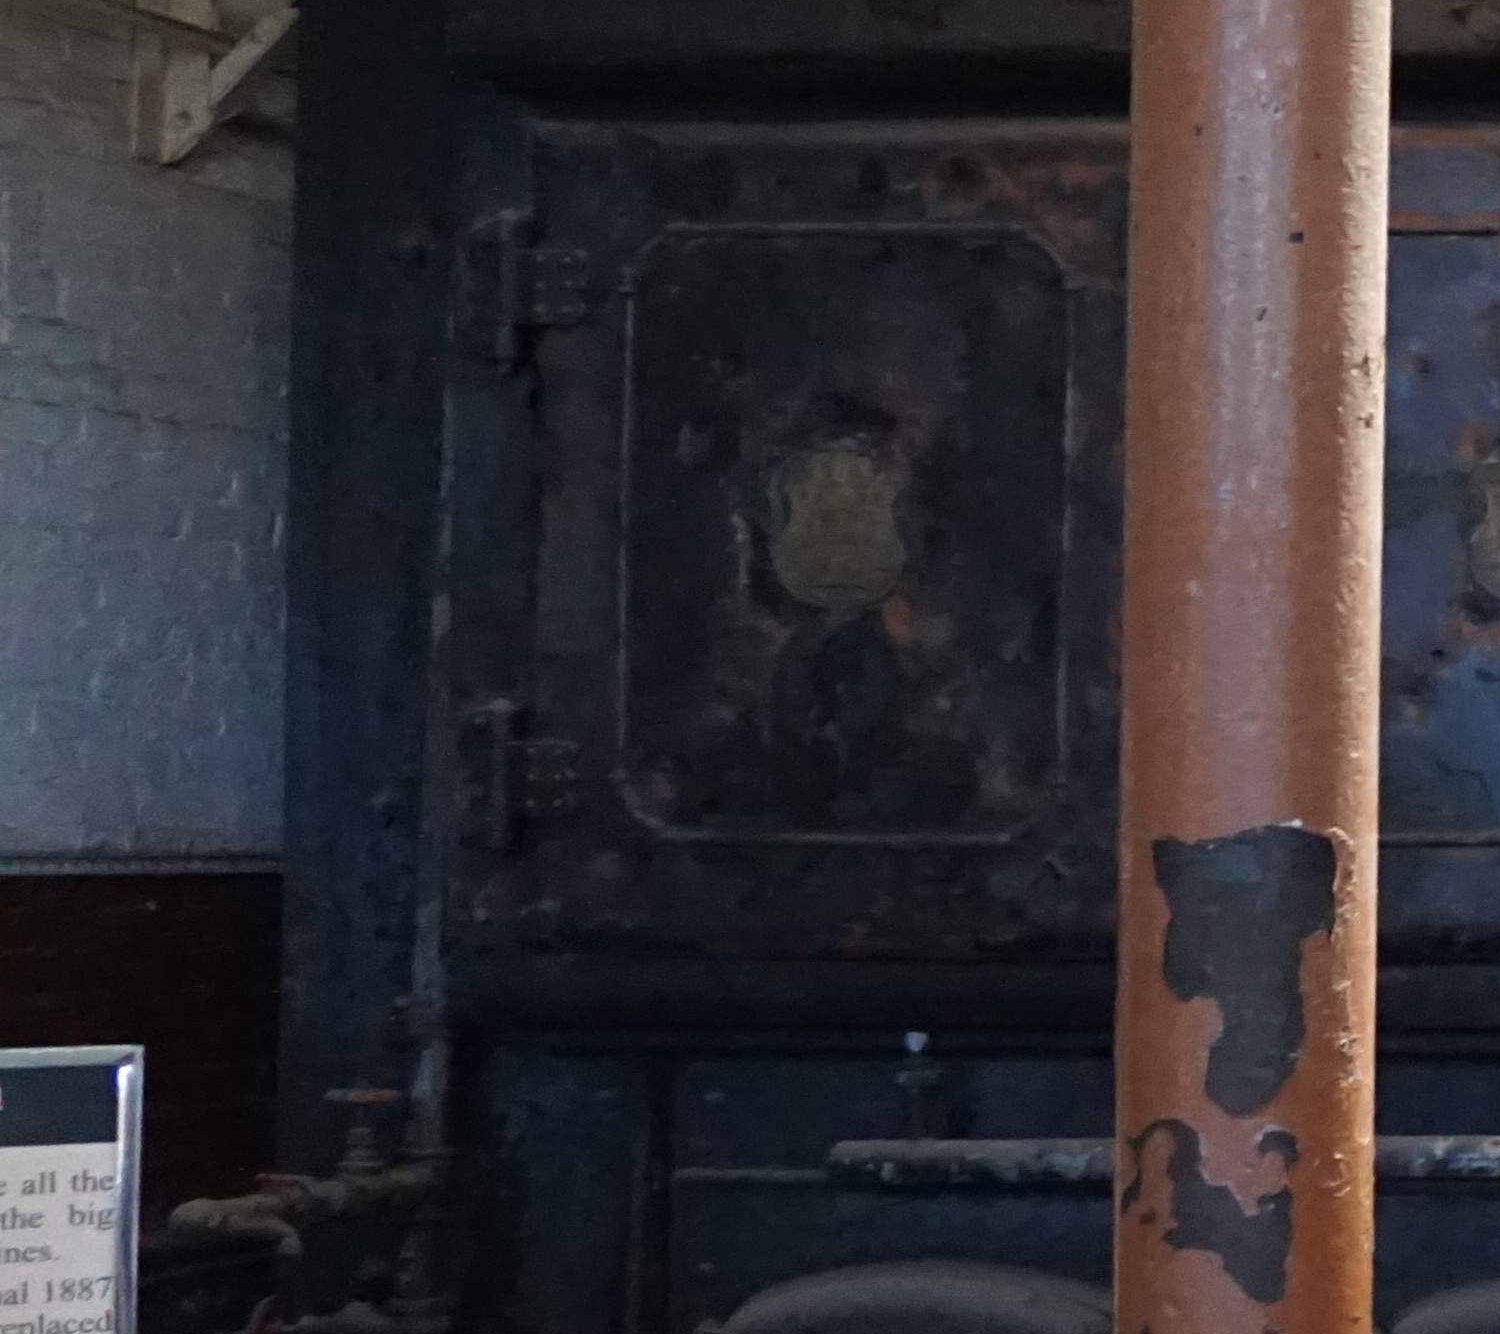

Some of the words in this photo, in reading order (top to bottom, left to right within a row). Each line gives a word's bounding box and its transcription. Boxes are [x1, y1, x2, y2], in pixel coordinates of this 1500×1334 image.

[21, 1170, 56, 1195] all
[70, 1169, 116, 1193] the
[0, 1206, 45, 1231] the
[67, 1203, 117, 1231] big
[0, 1243, 60, 1264] nes.
[45, 1275, 114, 1304] 1887
